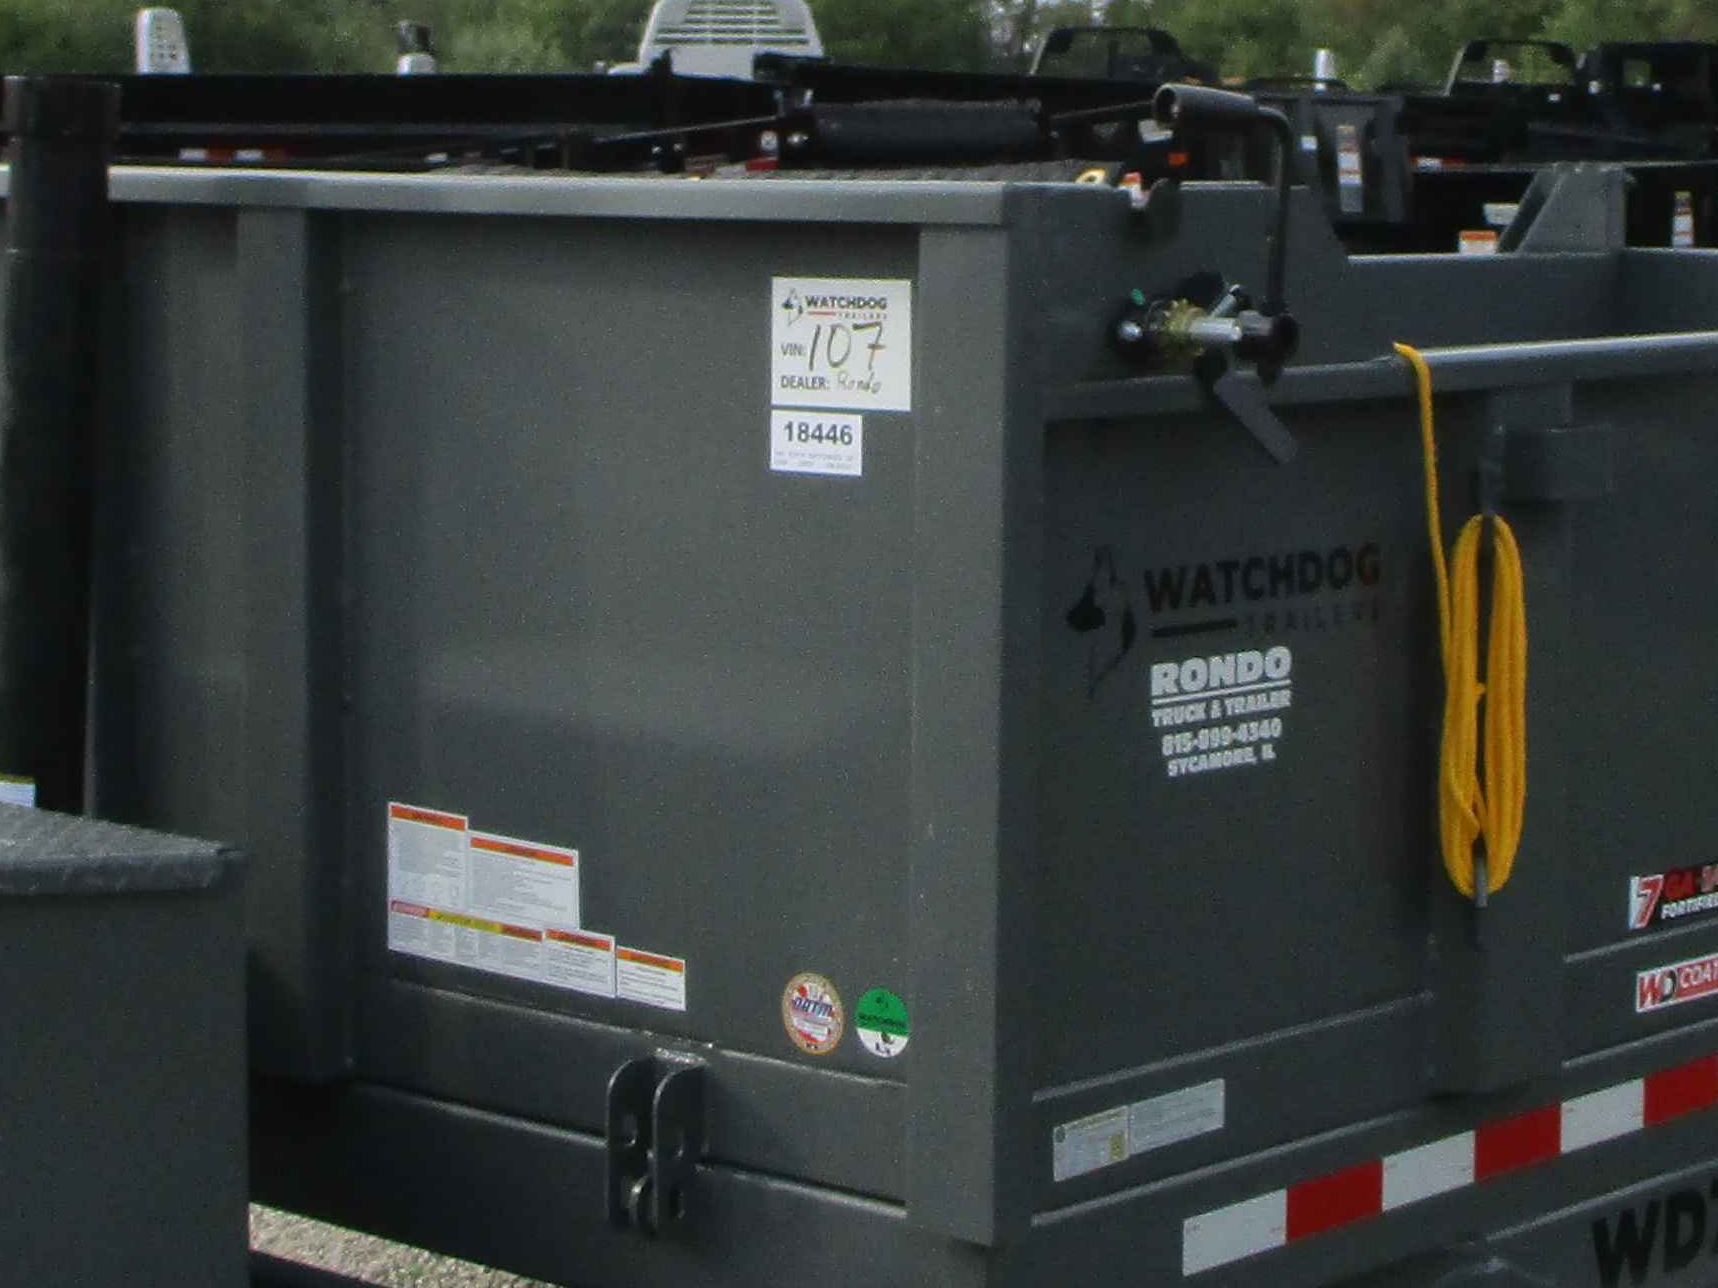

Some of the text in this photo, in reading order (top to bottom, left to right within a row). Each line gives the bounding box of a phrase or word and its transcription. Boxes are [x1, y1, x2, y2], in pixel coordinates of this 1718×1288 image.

[804, 295, 888, 310] WATCHDOG
[809, 321, 886, 371] 107
[781, 375, 830, 390] DEALER:
[784, 421, 854, 445] 18446
[1143, 542, 1381, 612] WATCHDOG
[1151, 646, 1292, 696] RONDO
[1152, 702, 1207, 727] TRUCK
[1225, 689, 1291, 715] TRAILER
